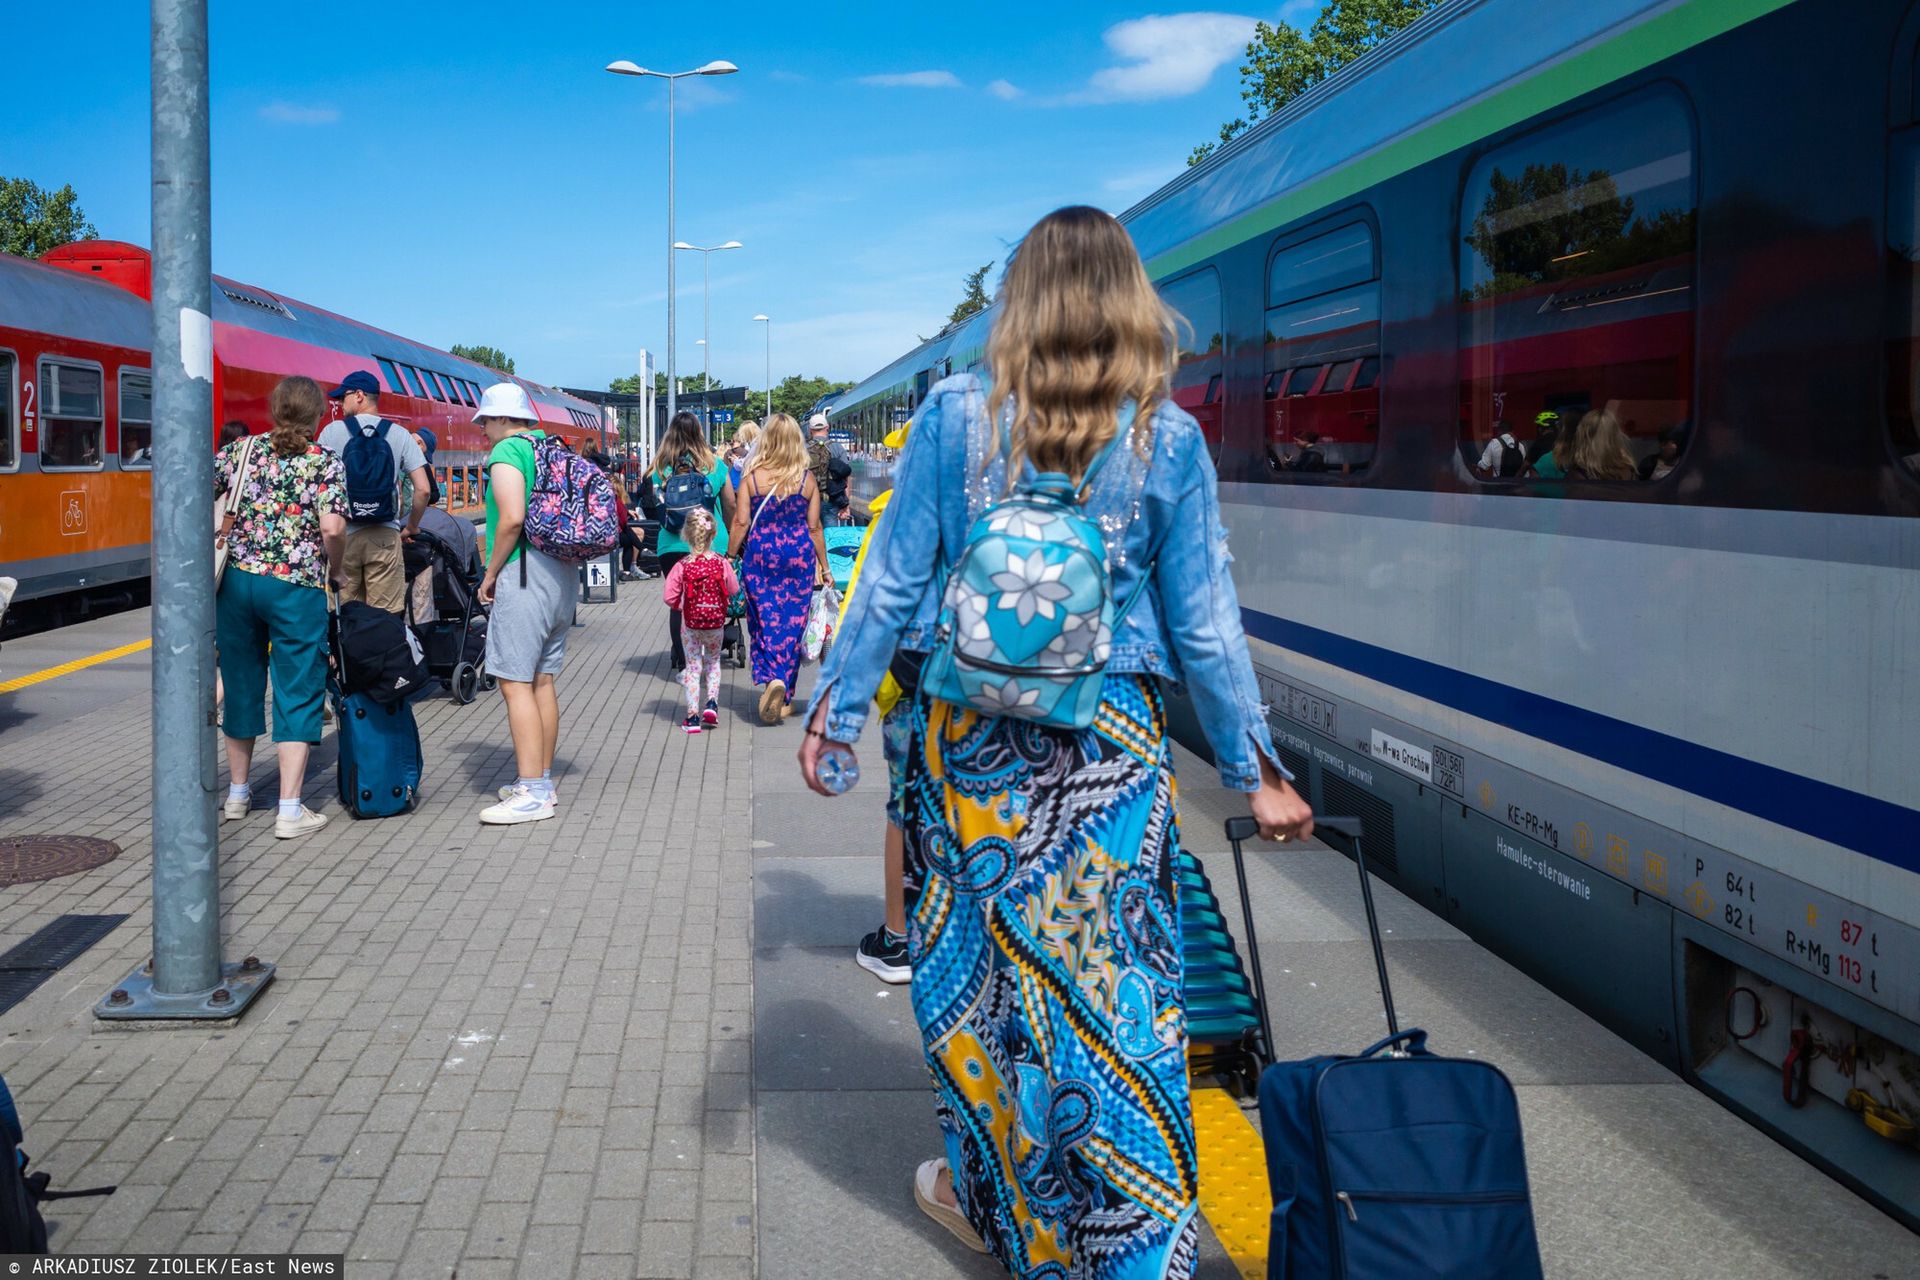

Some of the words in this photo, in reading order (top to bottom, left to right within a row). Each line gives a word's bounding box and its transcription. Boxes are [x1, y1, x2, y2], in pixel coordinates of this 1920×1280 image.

[24, 380, 35, 417] 2
[726, 413, 732, 422] 3
[353, 501, 380, 509] Reebok
[1382, 739, 1400, 761] W-wa
[1402, 748, 1430, 774] Grochów
[1507, 803, 1559, 848] KE-PR-Mg
[1496, 836, 1591, 900] Hamulec-sterowanie
[1695, 858, 1704, 877] P
[1726, 872, 1743, 897] 64
[1750, 882, 1755, 902] t
[1725, 904, 1743, 929] 82
[1749, 914, 1755, 935] t
[1841, 920, 1863, 946] 87
[1871, 933, 1879, 956] t
[1786, 930, 1830, 975] R+Mg
[1838, 954, 1862, 984] 113
[1870, 970, 1878, 993] t
